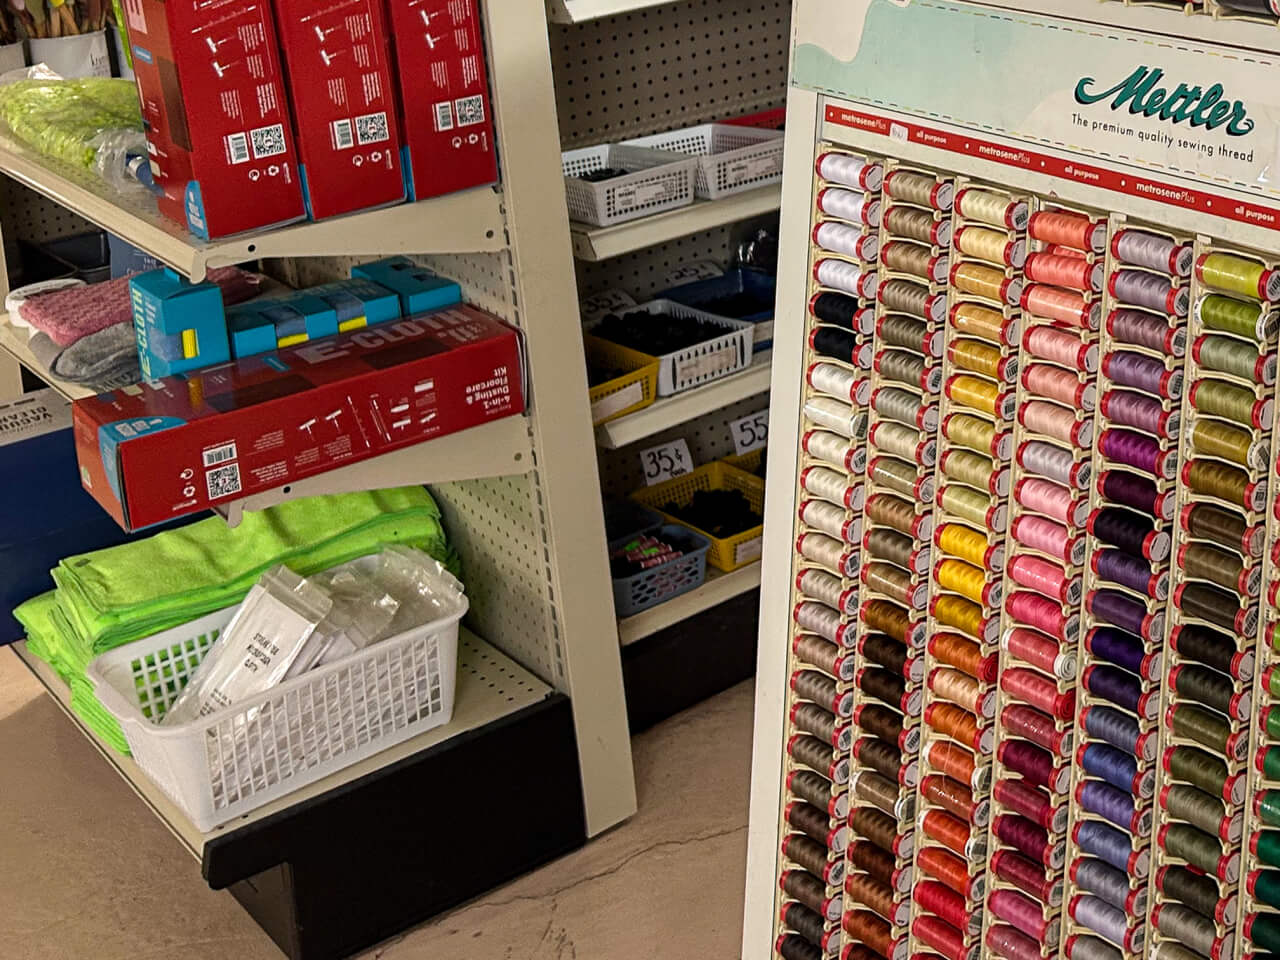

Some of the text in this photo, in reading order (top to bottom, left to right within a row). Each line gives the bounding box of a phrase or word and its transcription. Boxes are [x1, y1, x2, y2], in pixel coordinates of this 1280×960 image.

[1073, 65, 1255, 137] Mettler
[916, 130, 947, 144] all purpose
[1071, 113, 1255, 163] The premium quality sewing thread
[1064, 164, 1100, 181] all purpose
[1235, 205, 1275, 224] all purpose
[132, 287, 152, 382] E-CLOTH
[293, 308, 474, 365] E-CLOTH
